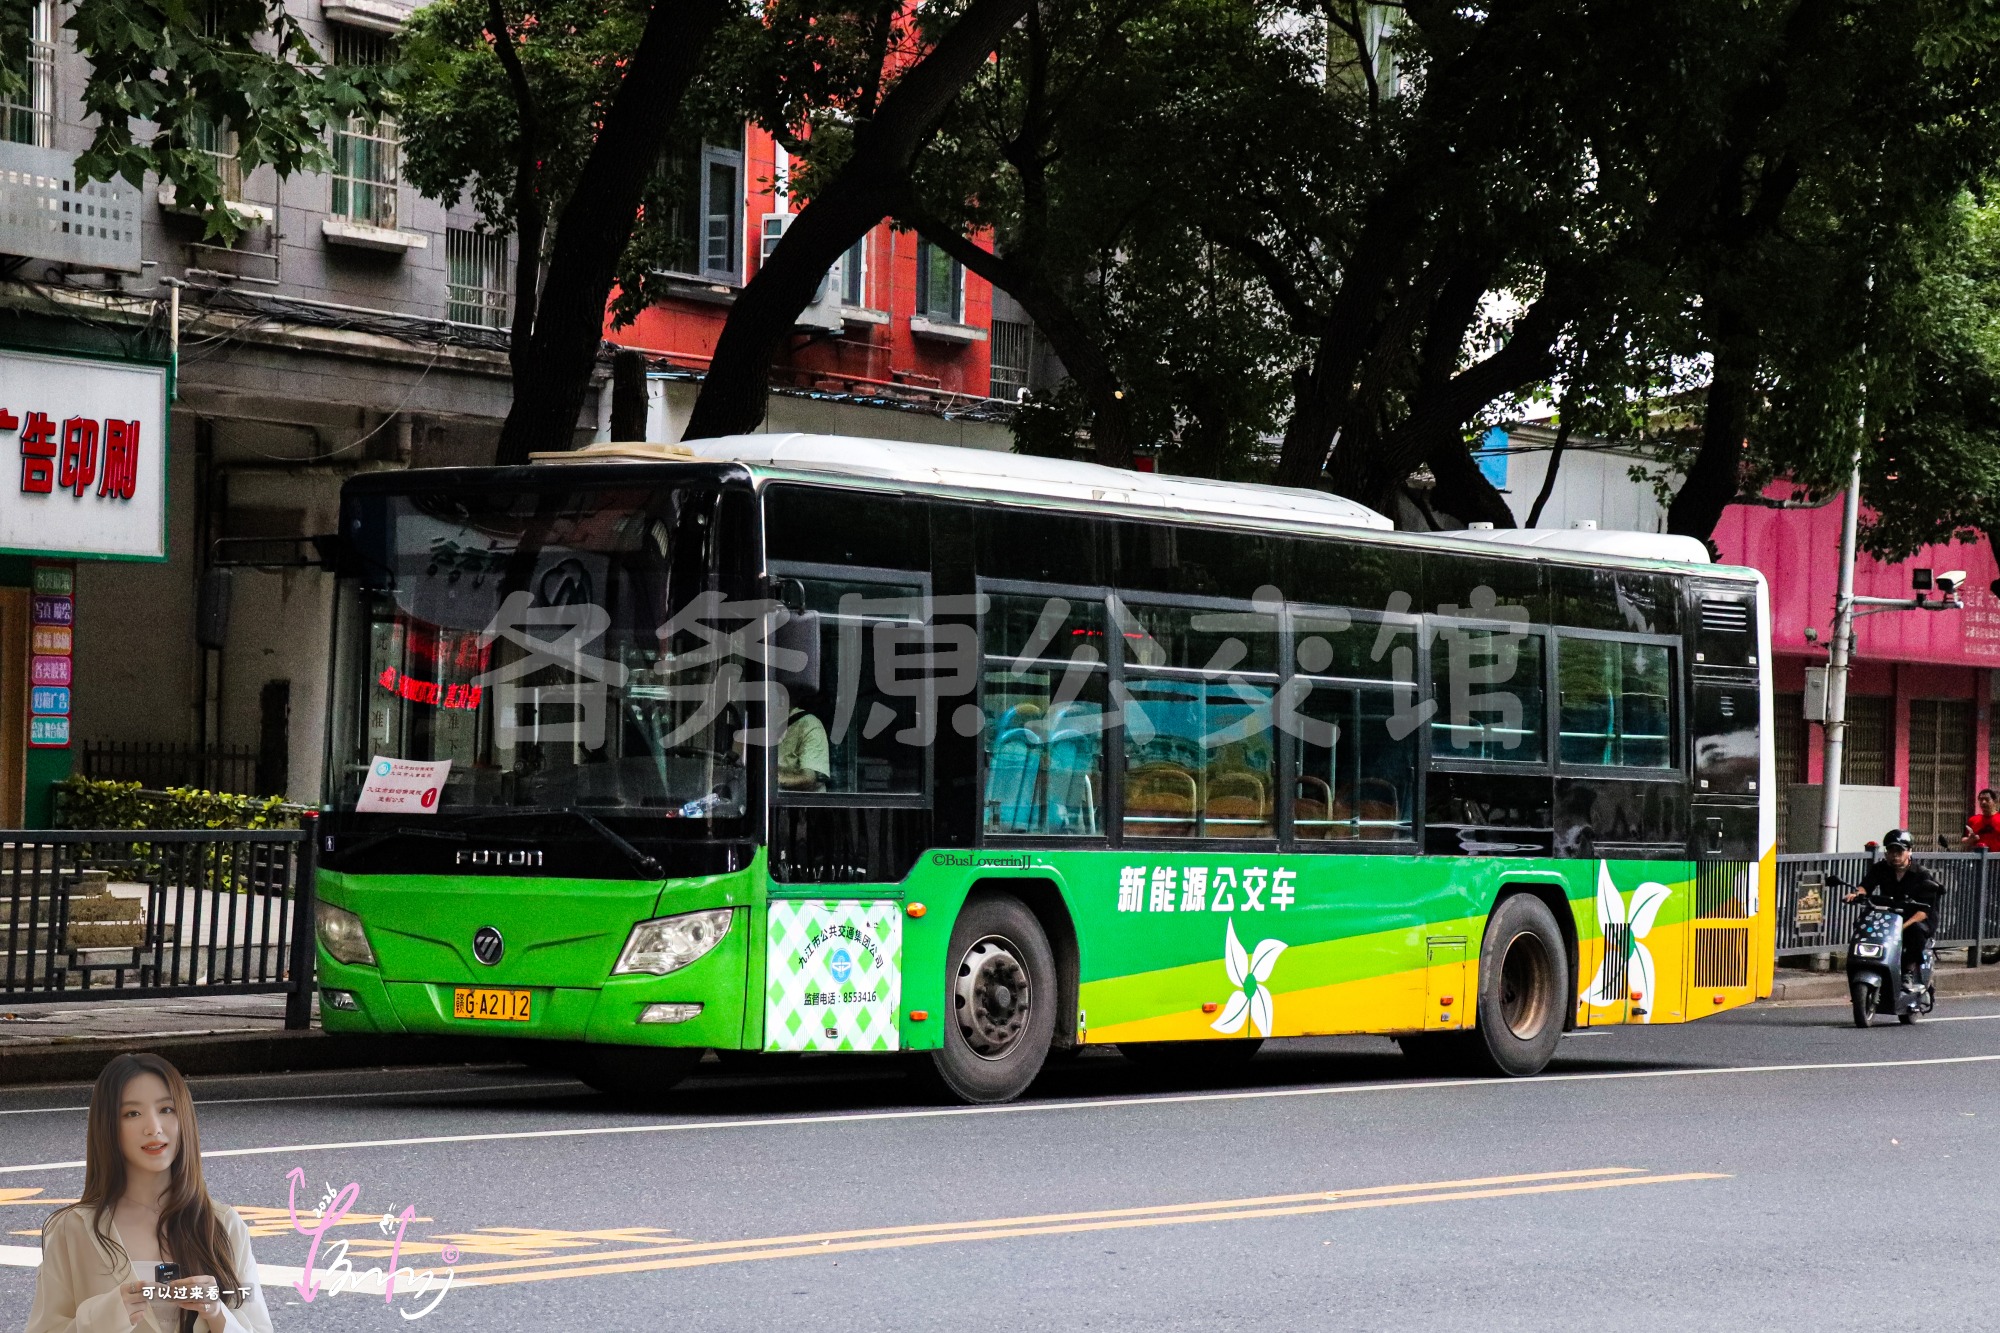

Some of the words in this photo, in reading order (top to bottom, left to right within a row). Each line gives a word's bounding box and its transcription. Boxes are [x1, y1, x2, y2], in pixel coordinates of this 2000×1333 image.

[34, 692, 67, 709] 灯箱广告
[426, 790, 434, 805] 1
[456, 850, 543, 866] FOTON
[1117, 865, 1297, 912] 新能源公交车
[798, 924, 884, 969] 九江市公共交通集团公司
